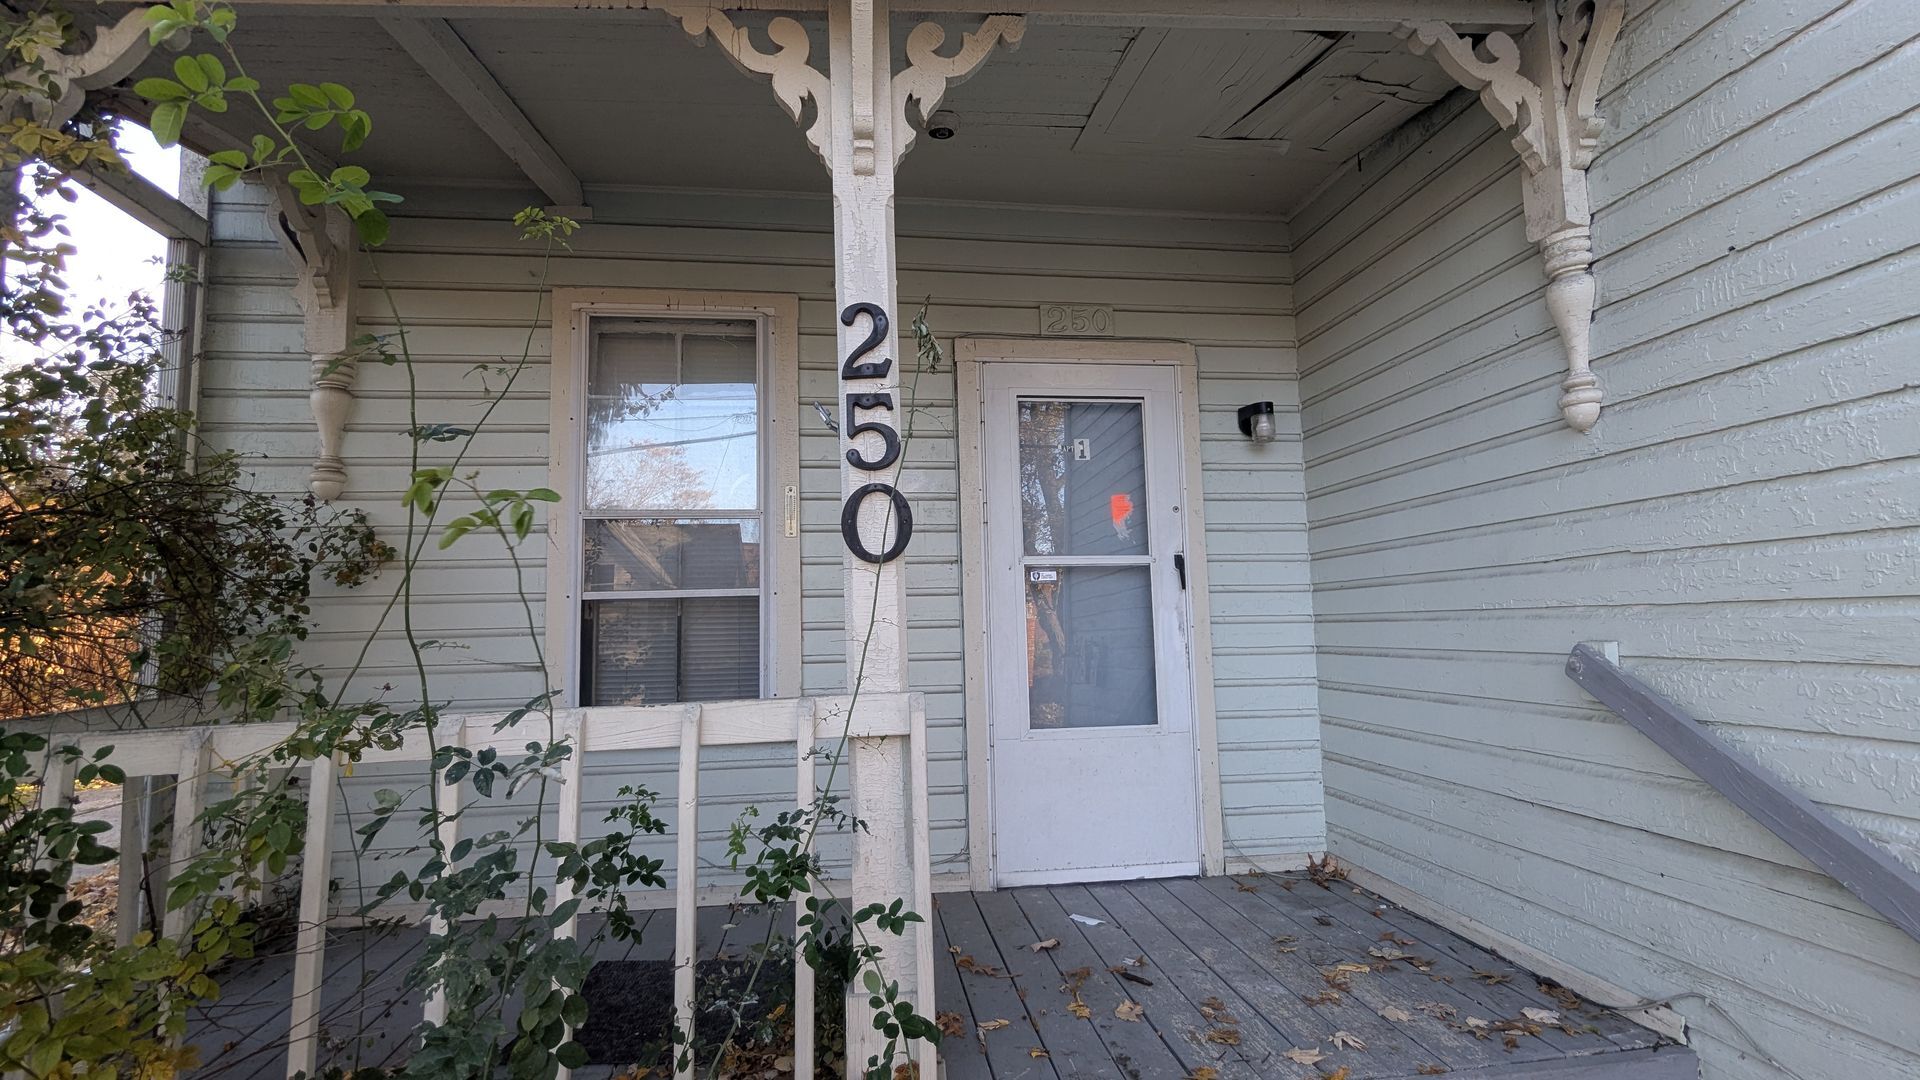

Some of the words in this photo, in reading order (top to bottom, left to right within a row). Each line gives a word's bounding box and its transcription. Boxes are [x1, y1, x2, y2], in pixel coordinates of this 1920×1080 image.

[1047, 306, 1110, 333] 250
[841, 302, 913, 564] 250
[1078, 440, 1087, 459] 1
